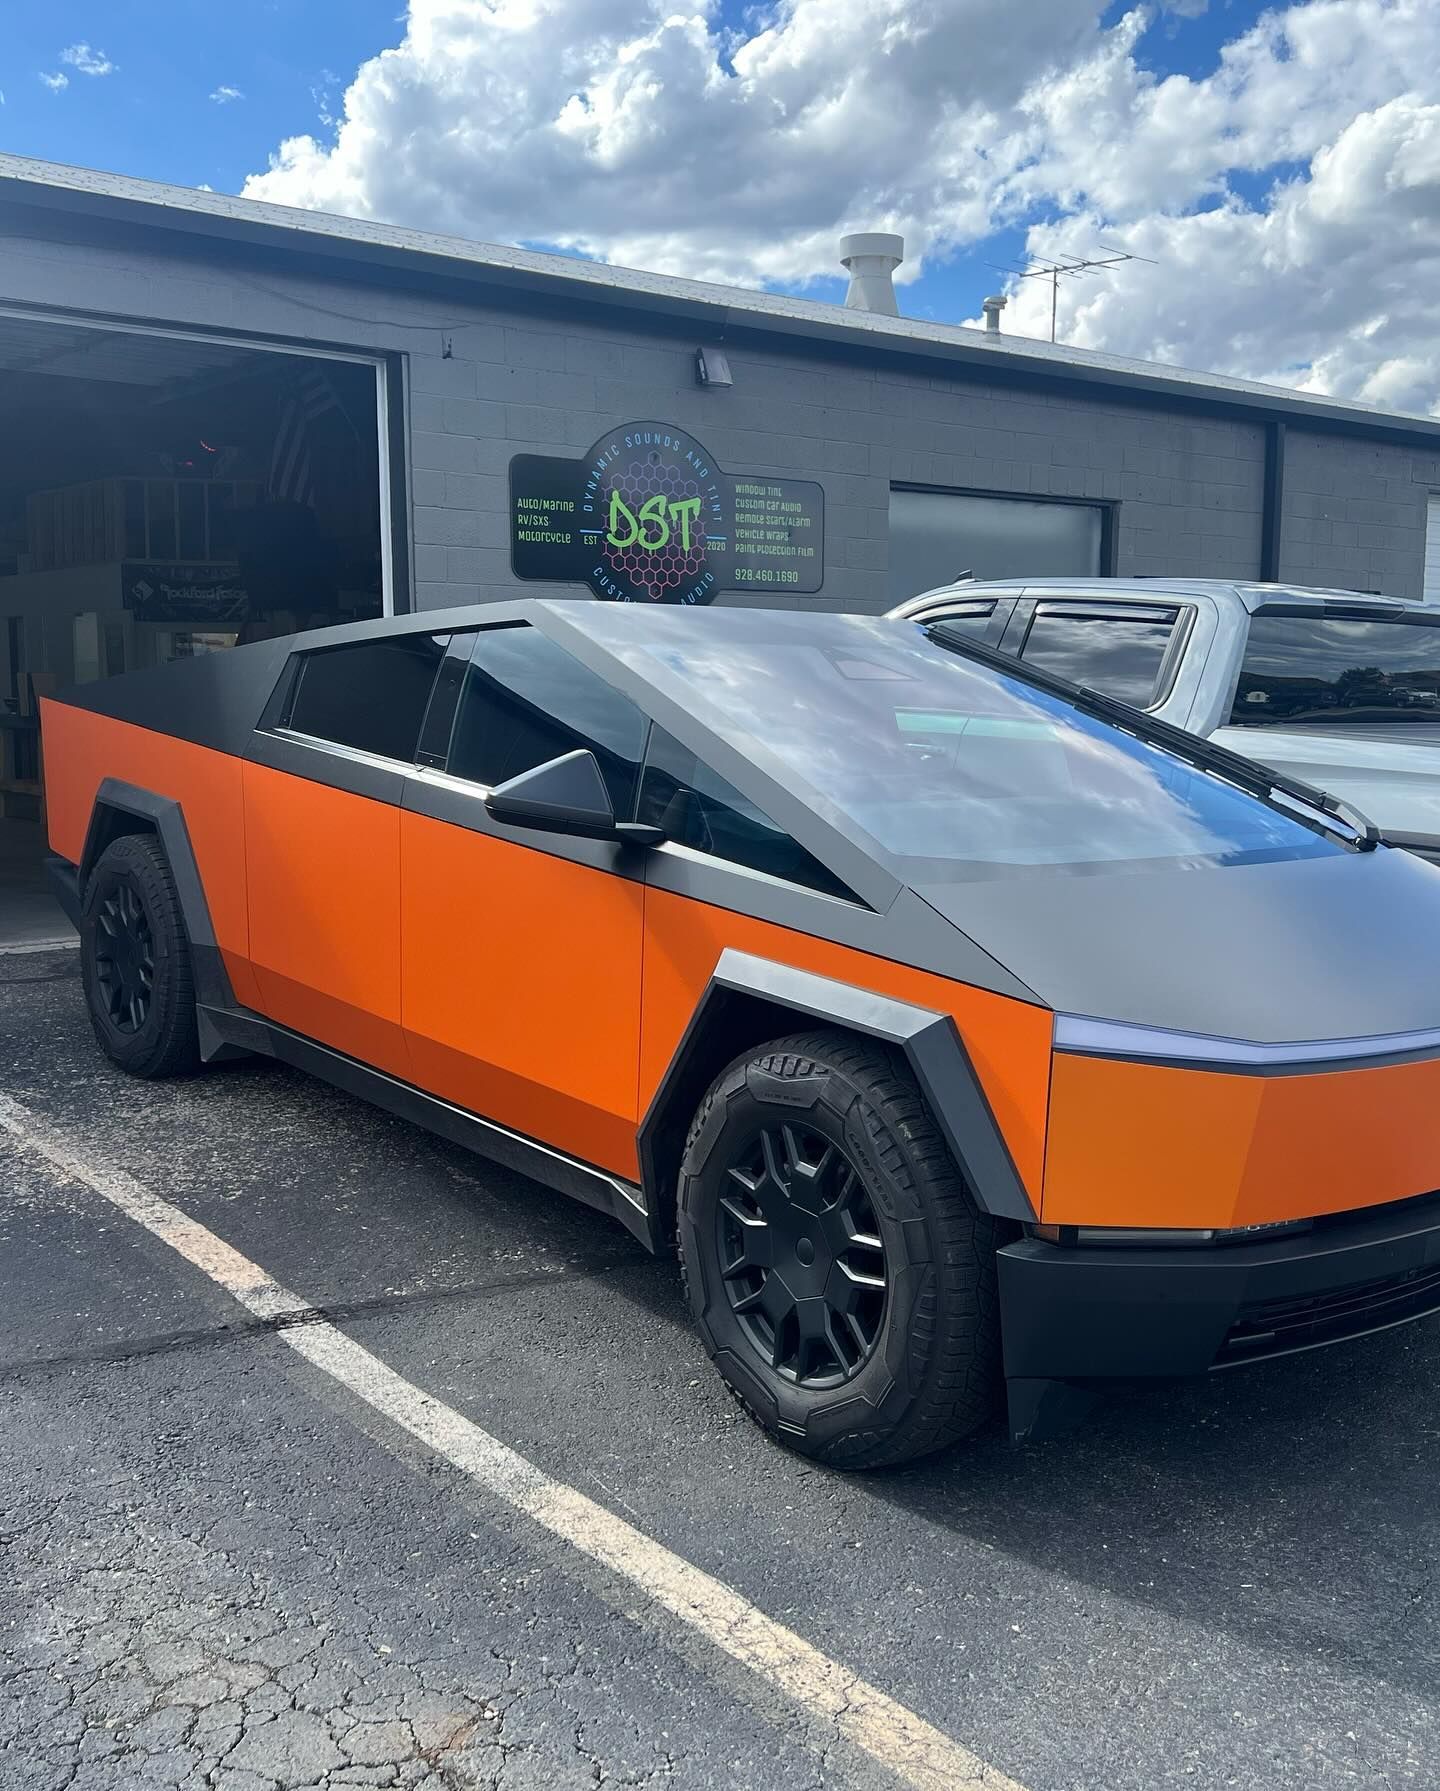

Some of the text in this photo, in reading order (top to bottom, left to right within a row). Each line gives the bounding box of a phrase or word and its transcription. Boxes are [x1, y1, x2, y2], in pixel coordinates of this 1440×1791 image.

[583, 432, 722, 522] DYNAMIC SOUNDS AND TINT
[606, 490, 701, 558] DST
[583, 535, 598, 545] EST
[706, 541, 726, 551] 2020
[593, 567, 714, 607] CUSTO AUDIO
[735, 568, 798, 583] 928.460.1690
